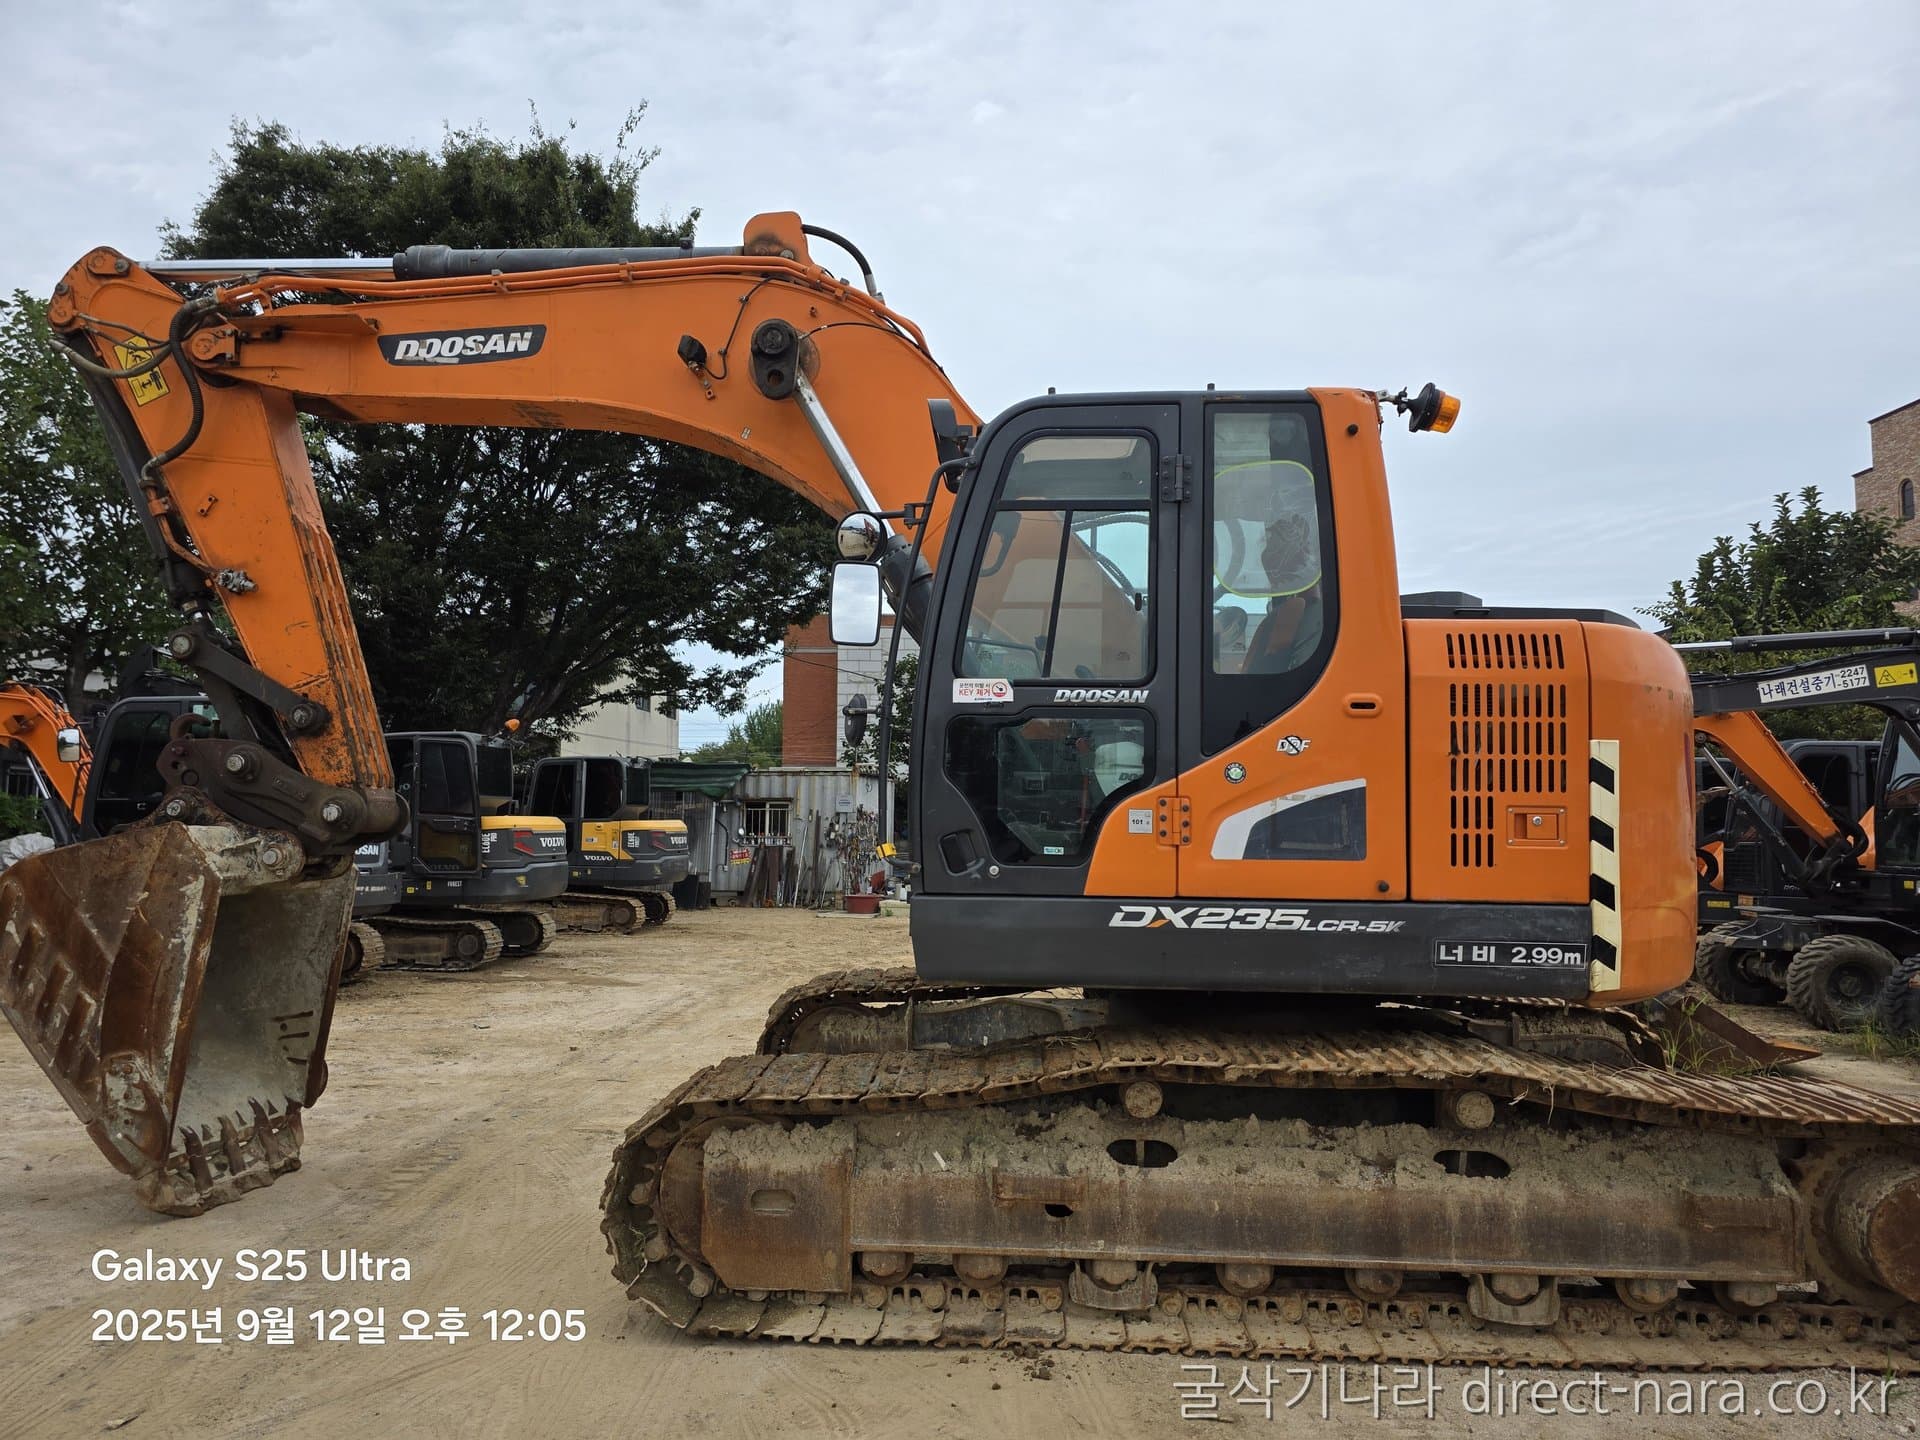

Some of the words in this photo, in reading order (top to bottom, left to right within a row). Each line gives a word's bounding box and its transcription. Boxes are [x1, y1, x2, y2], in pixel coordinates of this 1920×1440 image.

[394, 332, 533, 360] DOOSAN
[958, 688, 974, 697] KEY
[1761, 672, 1836, 700] 나래건설중기
[1053, 689, 1150, 703] DOOSAN
[540, 837, 565, 848] VOLVO
[1511, 946, 1581, 965] 2.99m
